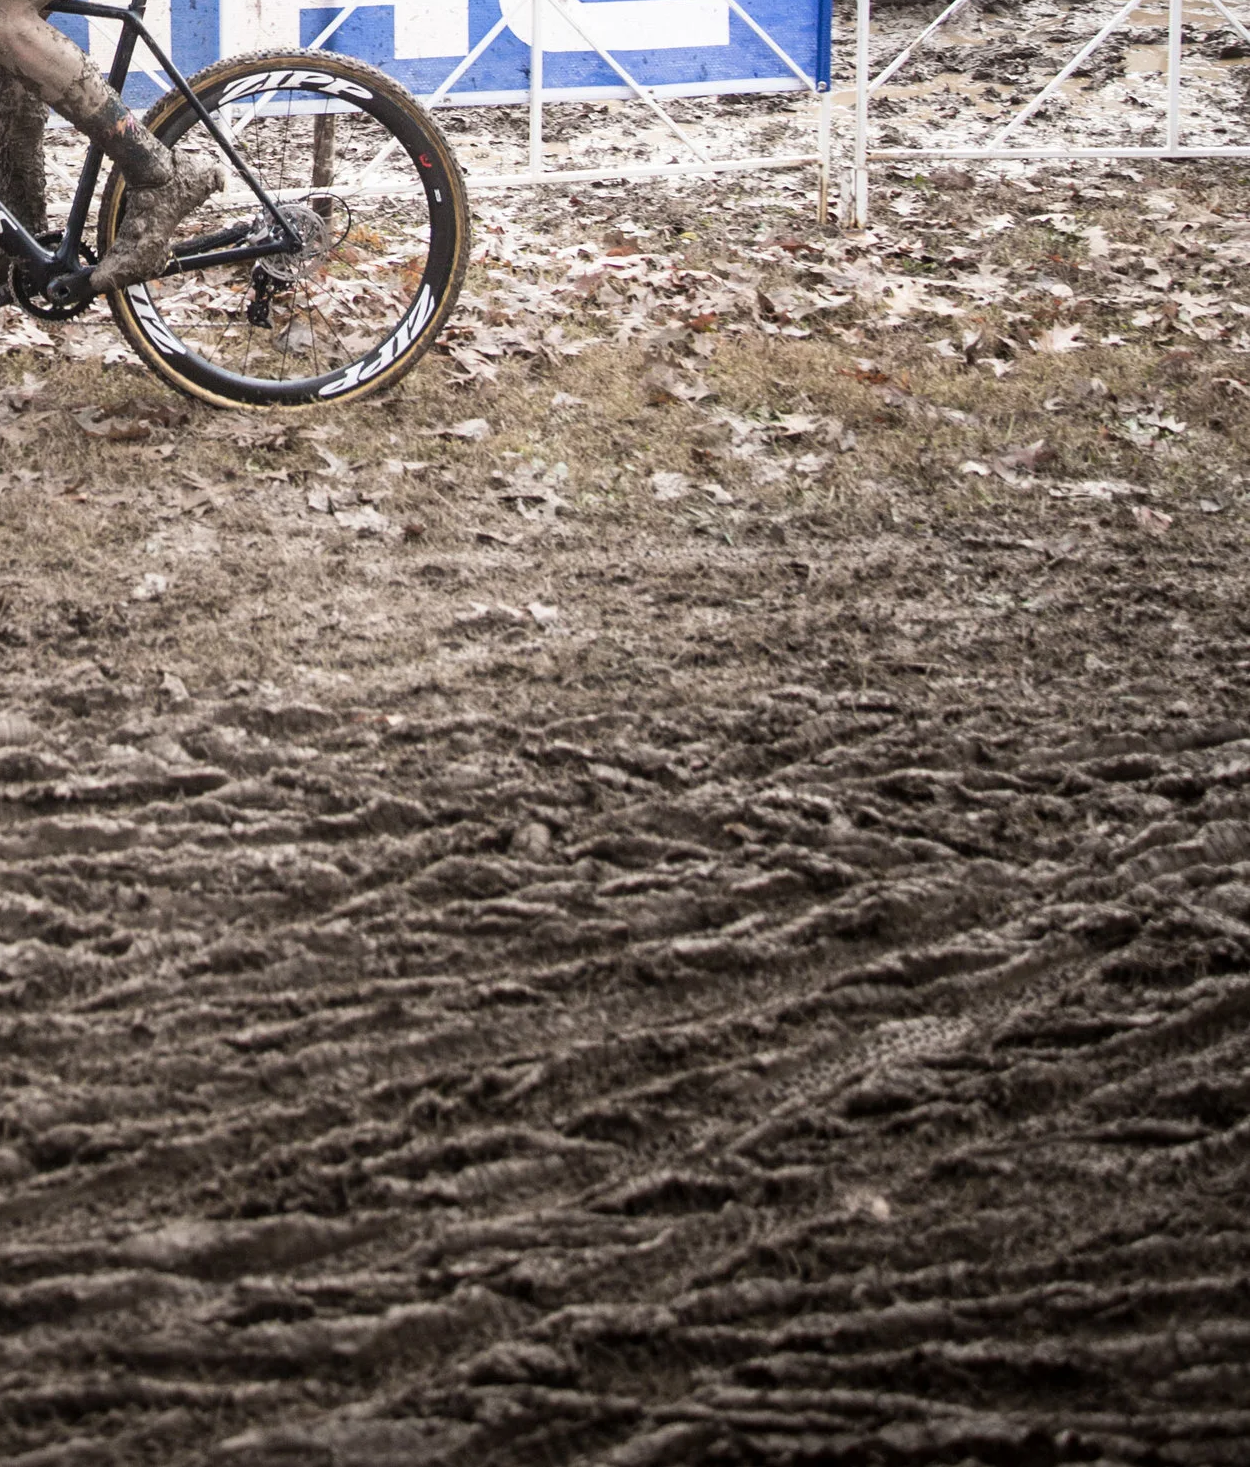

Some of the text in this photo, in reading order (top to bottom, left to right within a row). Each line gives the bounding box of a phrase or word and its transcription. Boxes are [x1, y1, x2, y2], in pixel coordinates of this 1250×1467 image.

[218, 70, 374, 105] ZIPP
[126, 282, 187, 355] ZI
[317, 283, 435, 396] ZIPP
